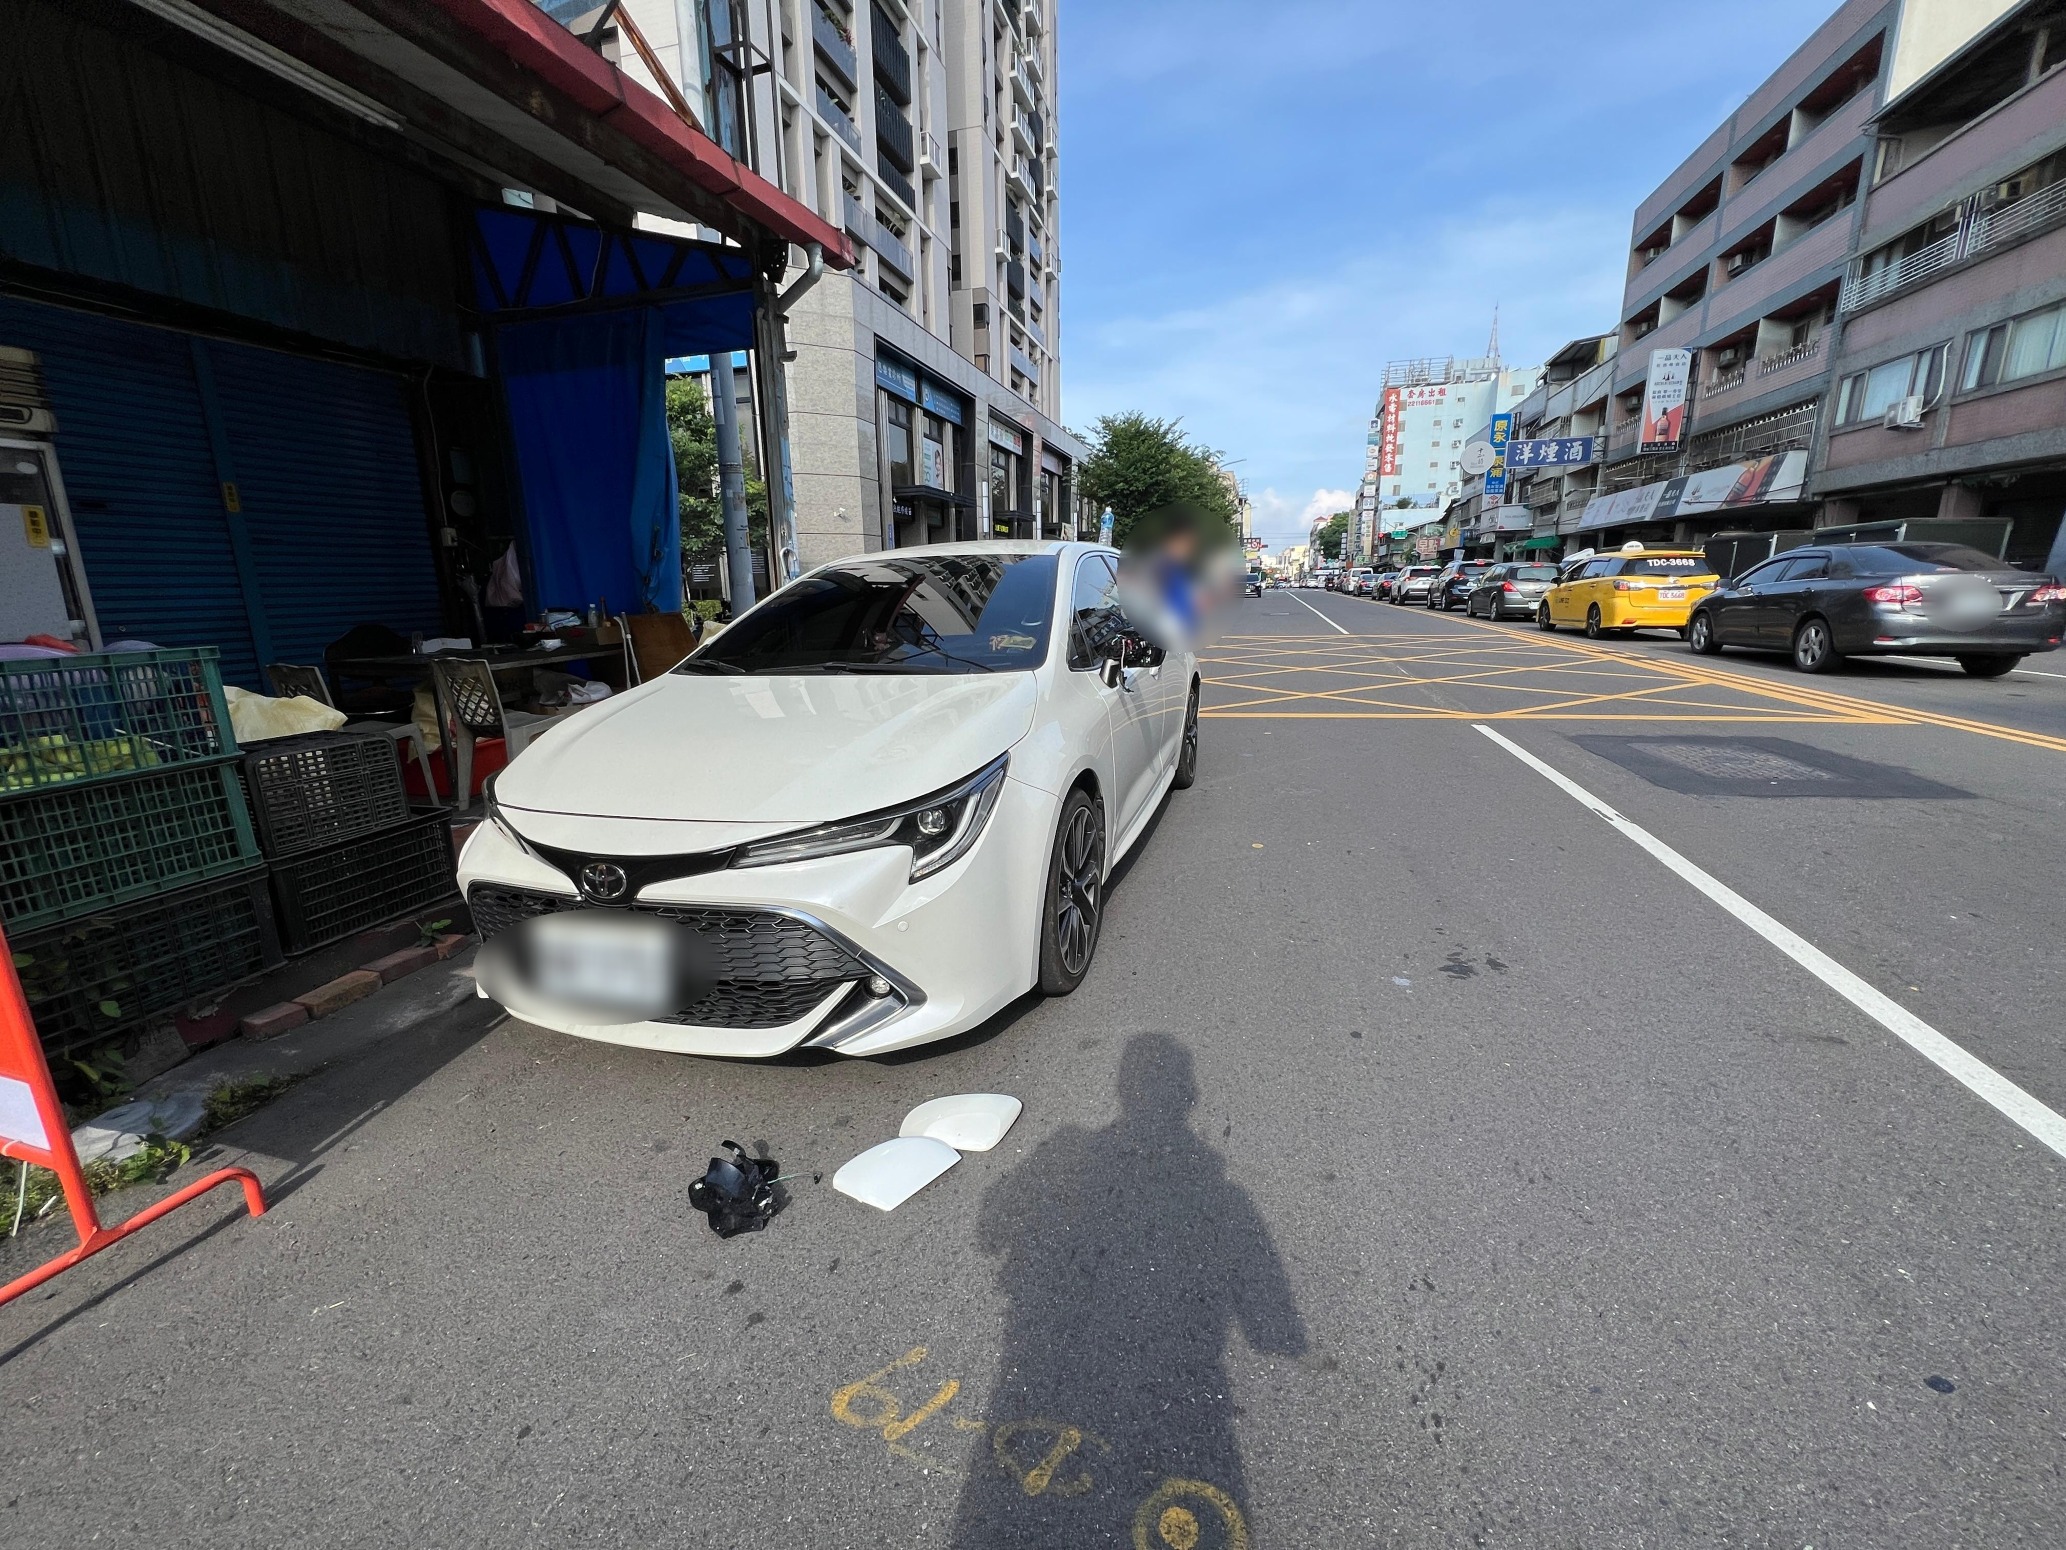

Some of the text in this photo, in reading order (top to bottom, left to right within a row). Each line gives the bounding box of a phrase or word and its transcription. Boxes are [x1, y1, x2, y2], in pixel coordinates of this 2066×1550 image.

[1407, 387, 1447, 399] 套房出租
[1383, 393, 1398, 473] 水電材料批發零售
[1515, 440, 1584, 465] 洋煙酒
[1418, 539, 1438, 553] 早點
[1647, 558, 1696, 567] TDC-3668
